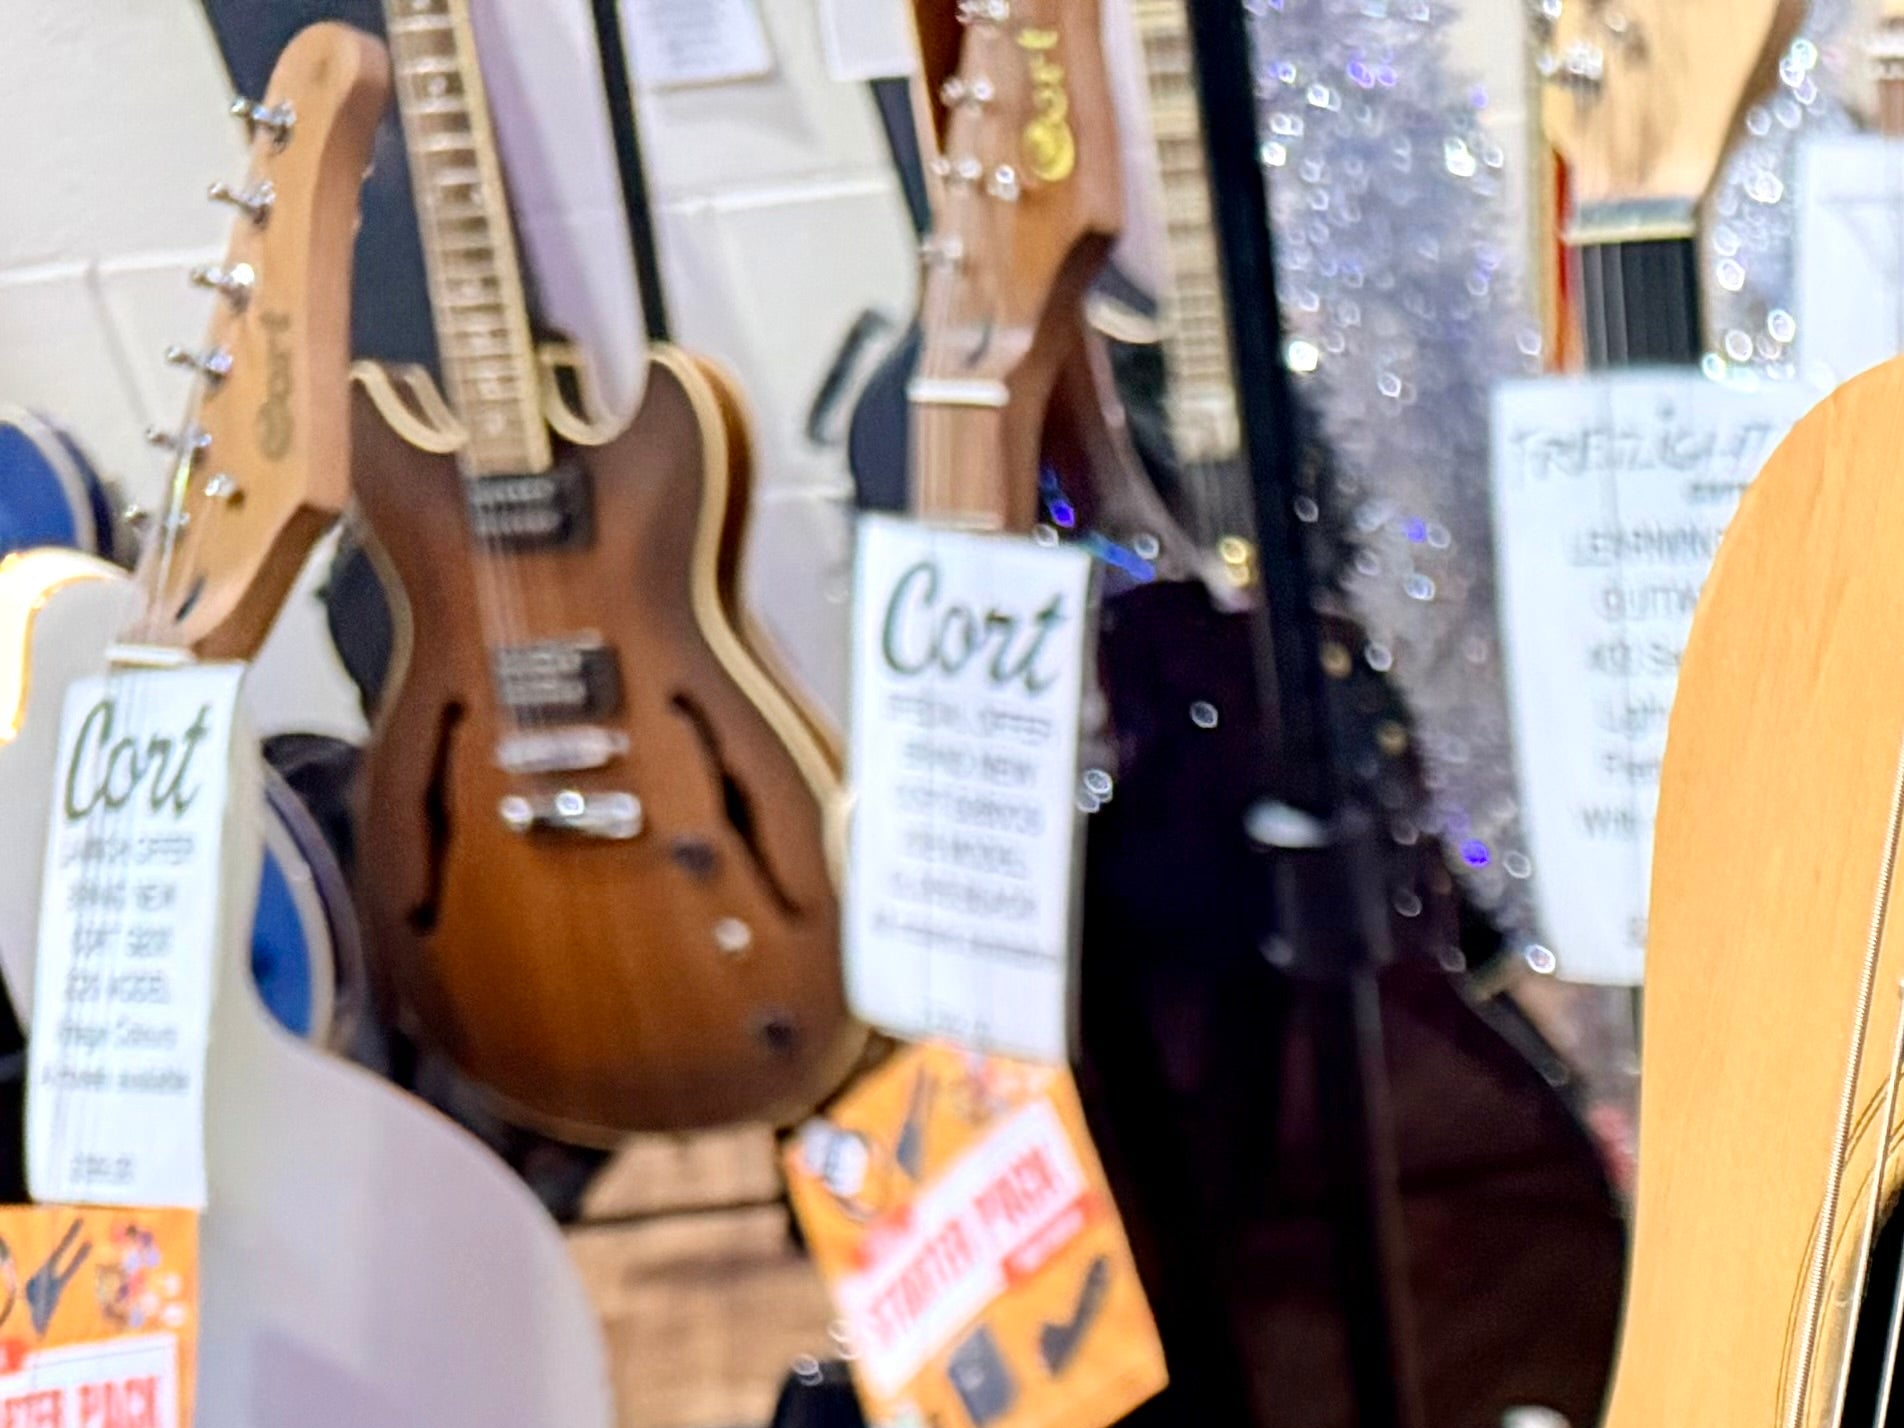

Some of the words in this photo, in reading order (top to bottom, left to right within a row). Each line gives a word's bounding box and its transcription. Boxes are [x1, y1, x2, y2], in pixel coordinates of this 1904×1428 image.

[882, 561, 1069, 693] Cort
[63, 700, 210, 824] Cort
[972, 1147, 1058, 1245] PACK
